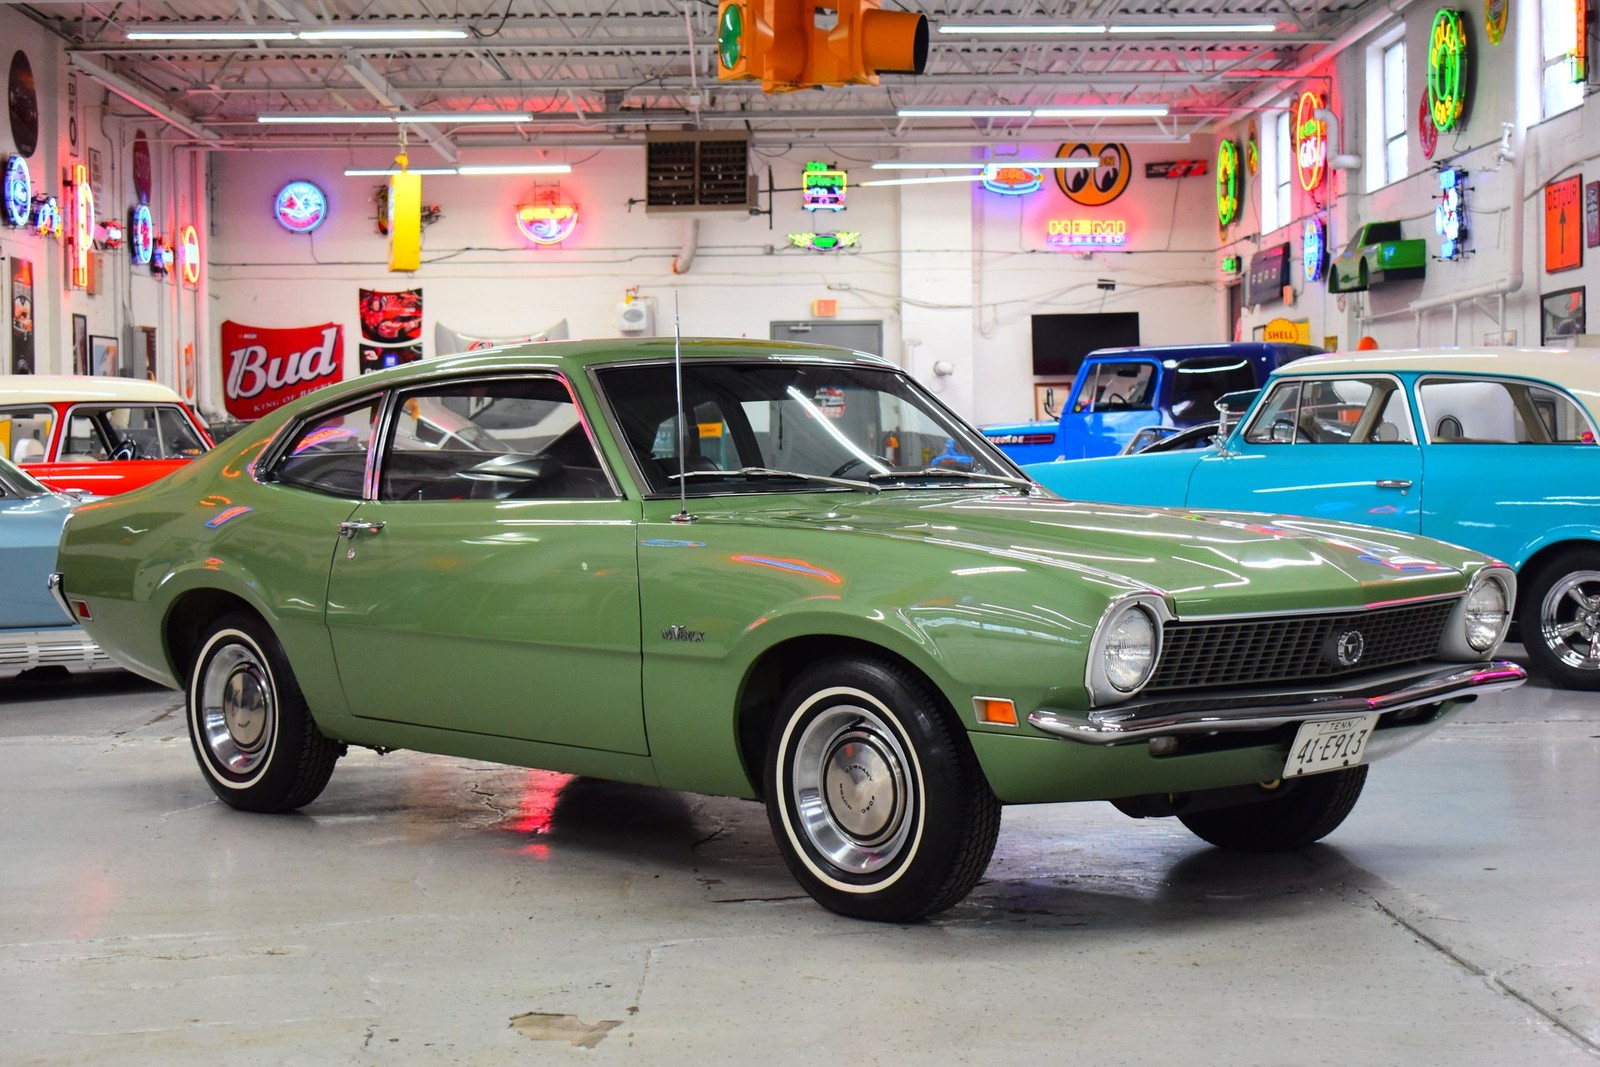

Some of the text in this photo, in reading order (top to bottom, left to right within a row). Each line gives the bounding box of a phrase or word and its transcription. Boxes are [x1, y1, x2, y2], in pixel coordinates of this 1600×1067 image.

[1435, 95, 1452, 125] GAS
[1300, 136, 1318, 168] GAS
[1547, 183, 1578, 211] DETOUR
[1049, 220, 1126, 235] HEMI
[1050, 235, 1123, 244] POWERED
[1252, 267, 1277, 285] FORD
[1267, 331, 1294, 340] SHELL
[226, 326, 338, 400] Bud
[253, 400, 279, 412] KING
[282, 394, 296, 404] OF
[986, 434, 1025, 444] NEGADE
[661, 624, 705, 643] MAVERICK
[1329, 720, 1354, 731] TENN
[839, 764, 876, 814] FORD MOTOR COMPANY
